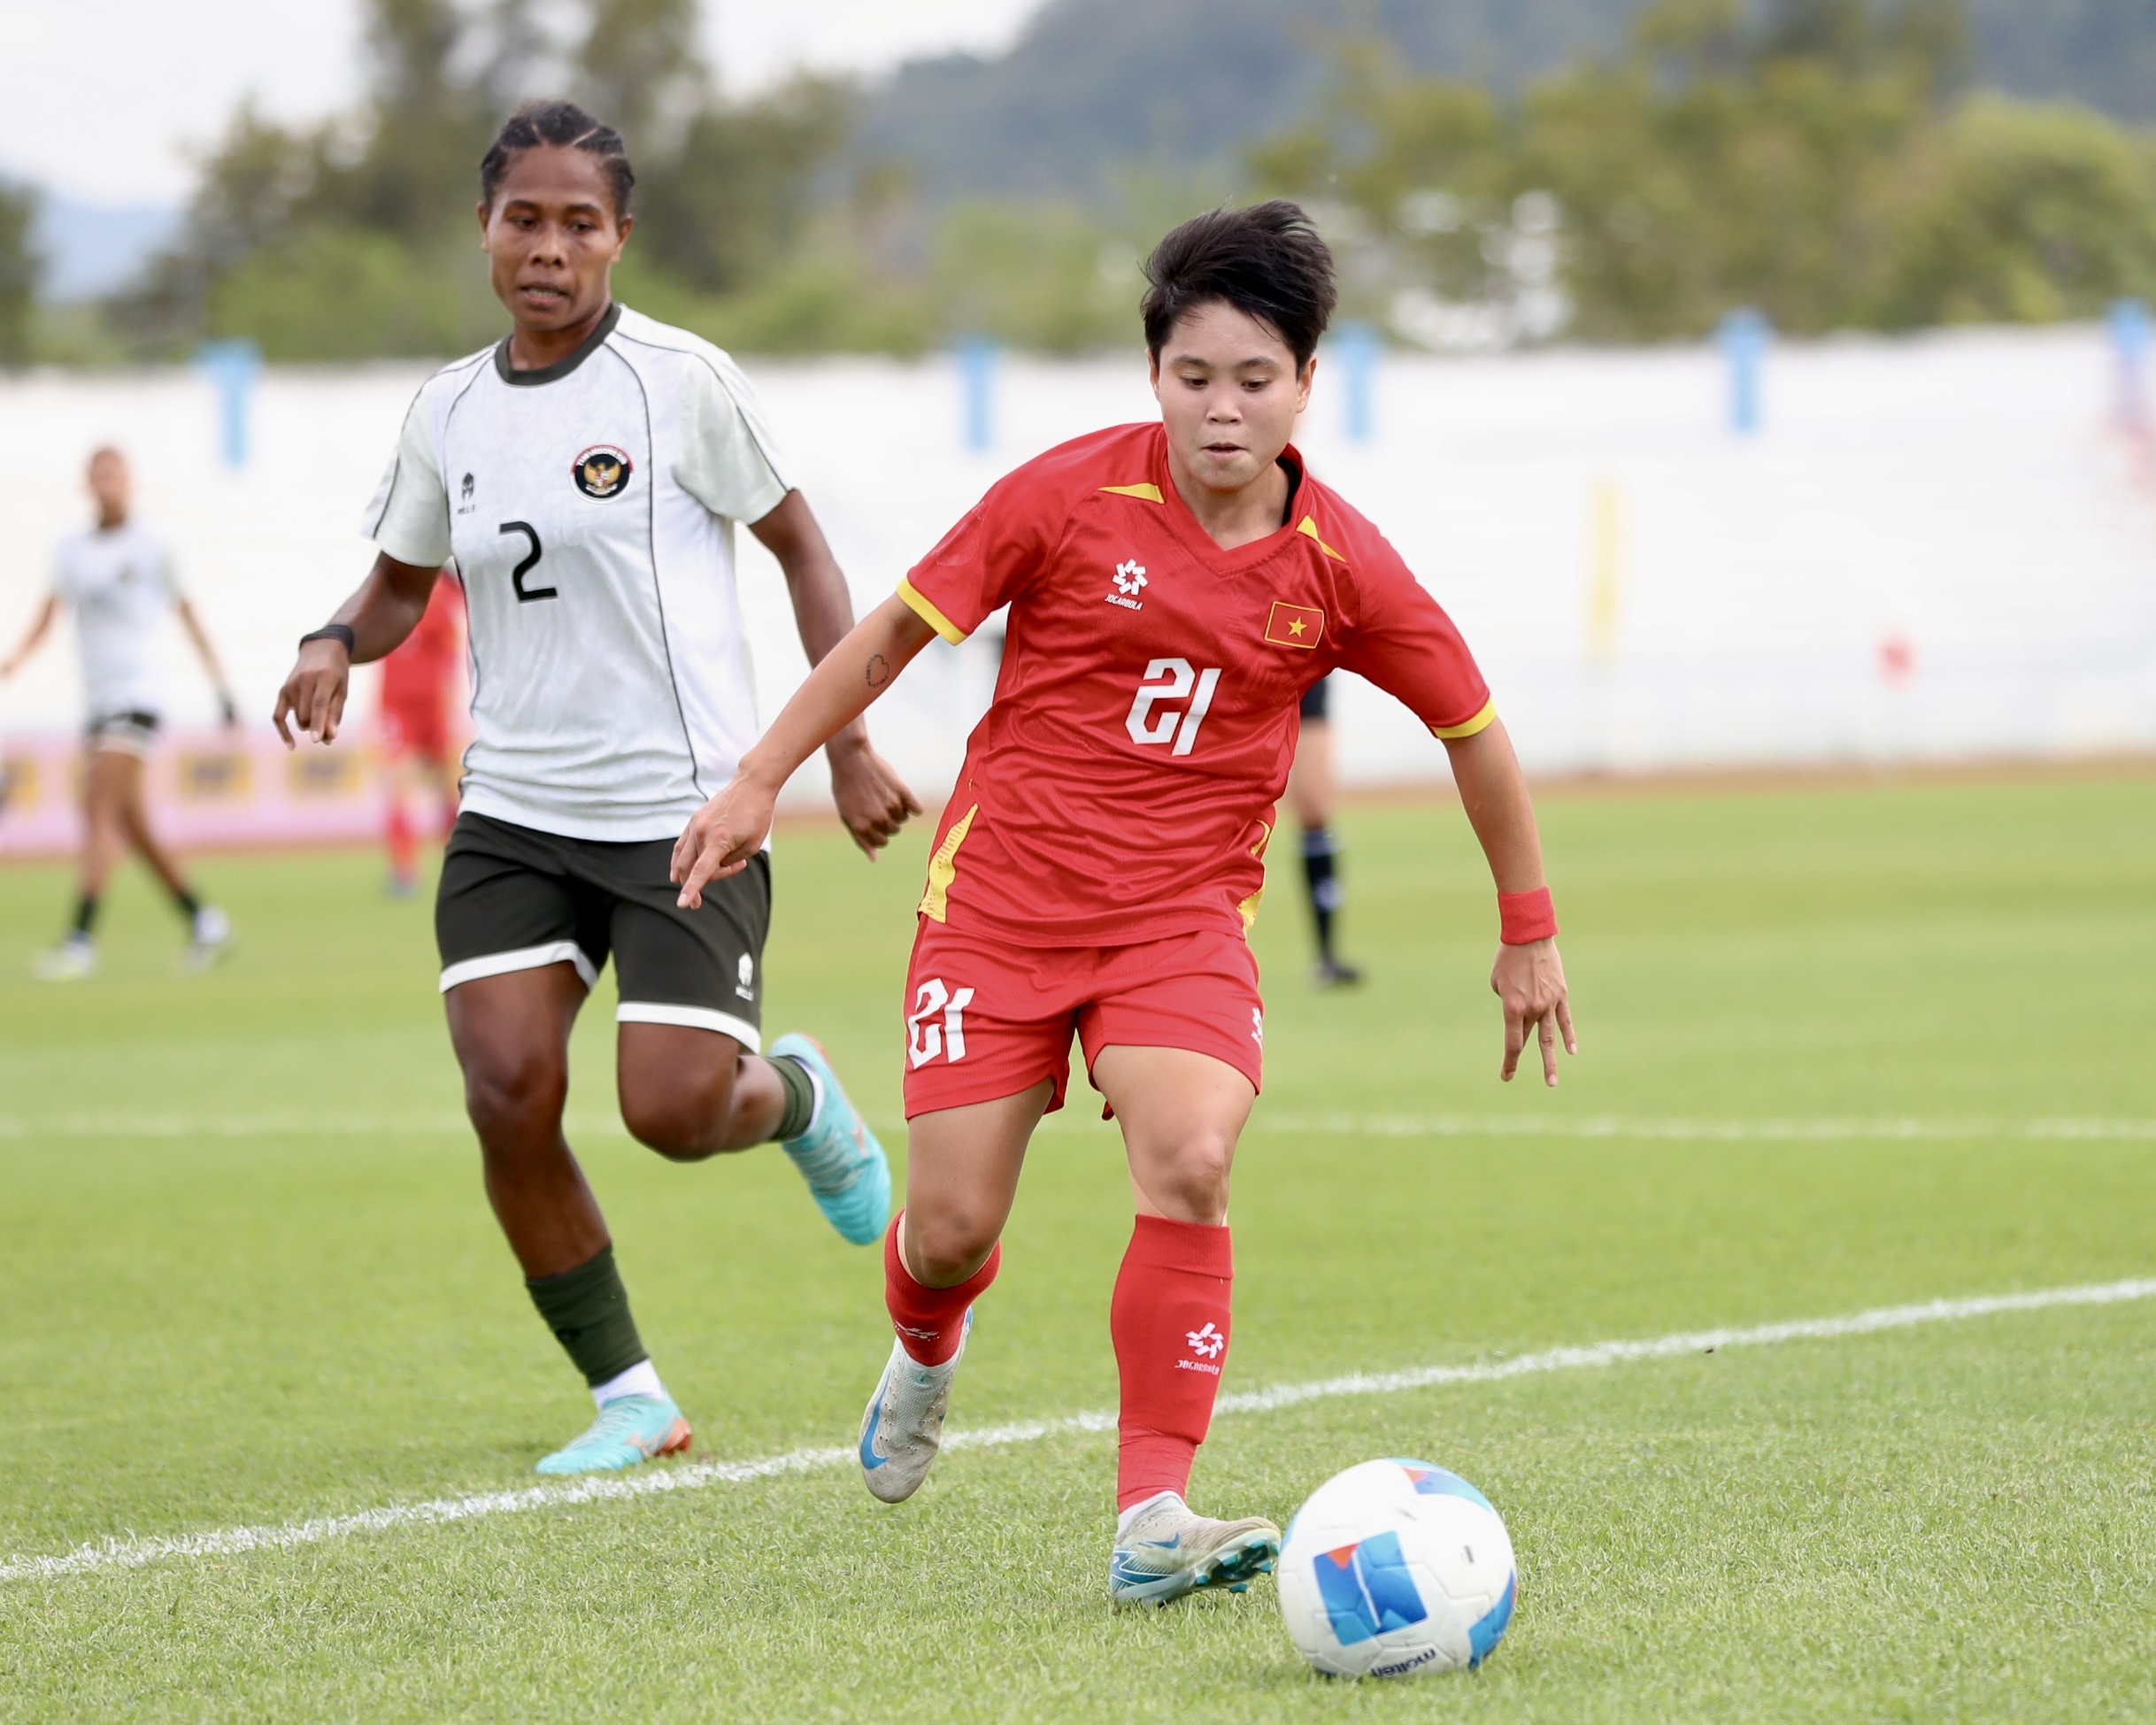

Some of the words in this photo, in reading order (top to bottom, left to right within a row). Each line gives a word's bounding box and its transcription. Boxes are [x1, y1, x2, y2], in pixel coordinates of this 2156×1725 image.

[498, 520, 558, 604] 2
[1124, 658, 1222, 757] 21
[907, 977, 975, 1070] 21
